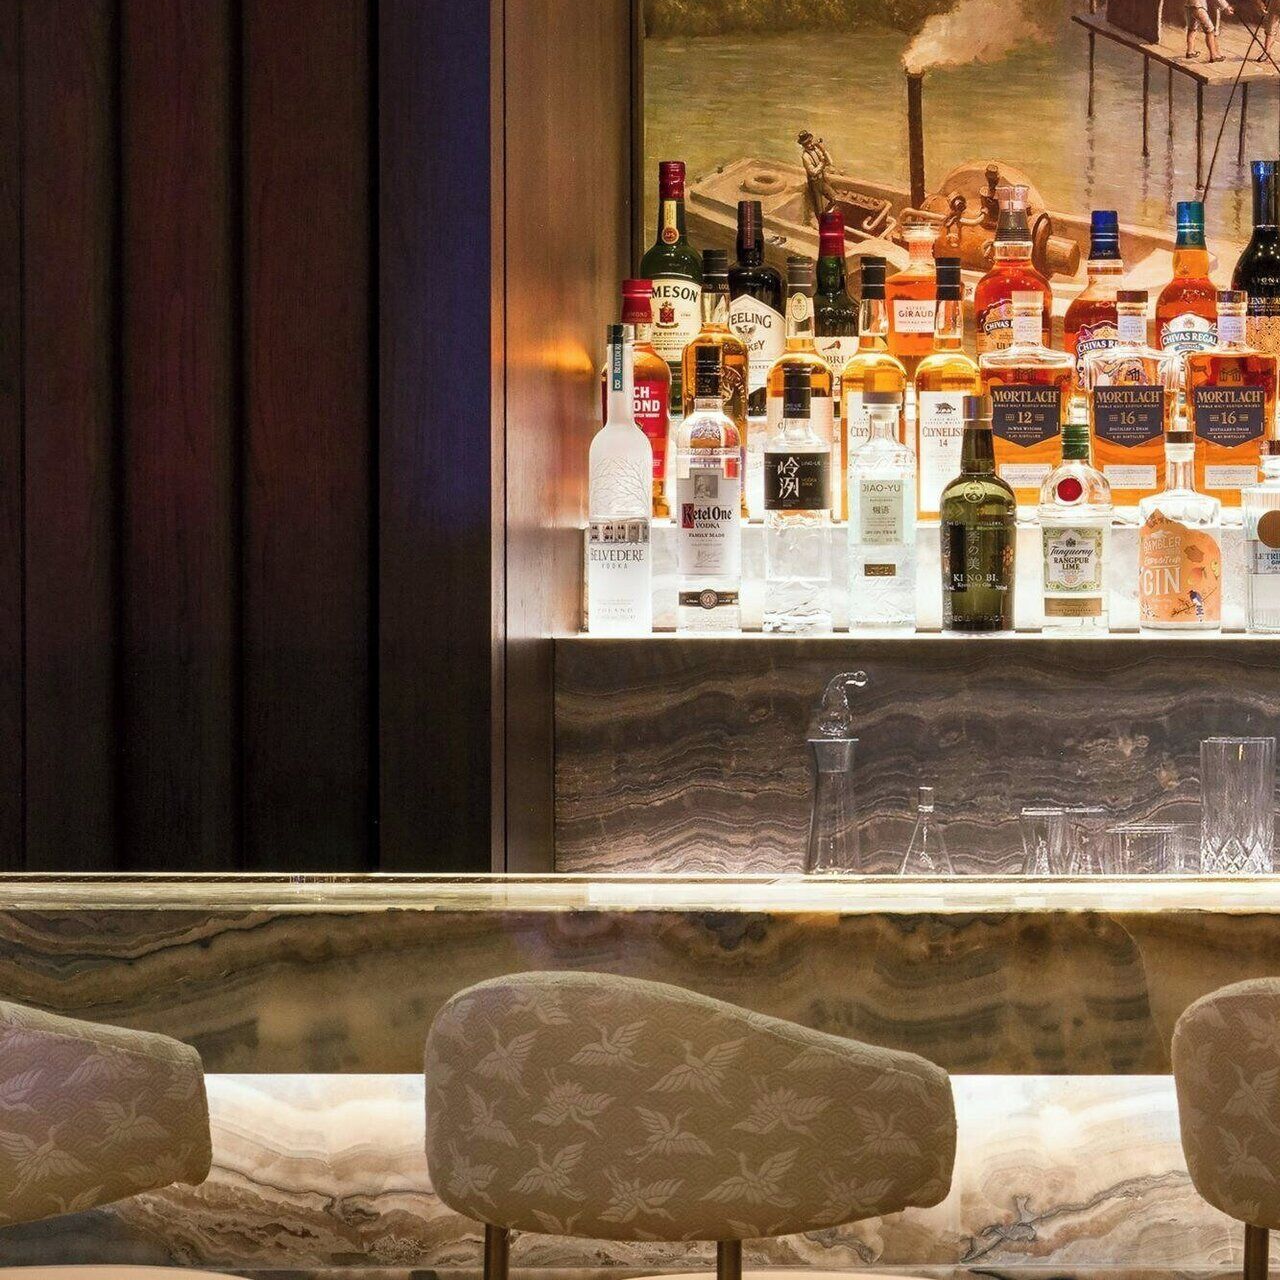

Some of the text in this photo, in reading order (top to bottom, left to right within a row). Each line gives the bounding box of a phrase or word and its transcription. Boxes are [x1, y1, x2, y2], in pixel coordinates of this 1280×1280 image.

[652, 286, 698, 302] MESON
[729, 312, 772, 328] EELING
[986, 321, 1010, 330] CHIVAS
[1162, 333, 1190, 345] CHIVAS
[1079, 341, 1106, 352] CHIVAS
[634, 387, 650, 397] CH
[993, 391, 1056, 403] MORTLACH
[1097, 391, 1160, 403] MORTLACH
[1197, 391, 1261, 403] MORTLACH
[634, 400, 660, 412] OND
[1017, 412, 1032, 424] 12
[1120, 412, 1135, 424] 16
[1221, 411, 1237, 424] 16
[939, 439, 948, 447] 14
[861, 484, 900, 492] JIAO-YU
[713, 507, 732, 521] One
[590, 548, 644, 562] BELVEDERE
[1050, 546, 1094, 557] Tanqueray
[953, 574, 965, 582] KI
[968, 574, 982, 582] NO
[1143, 567, 1181, 596] GIN
